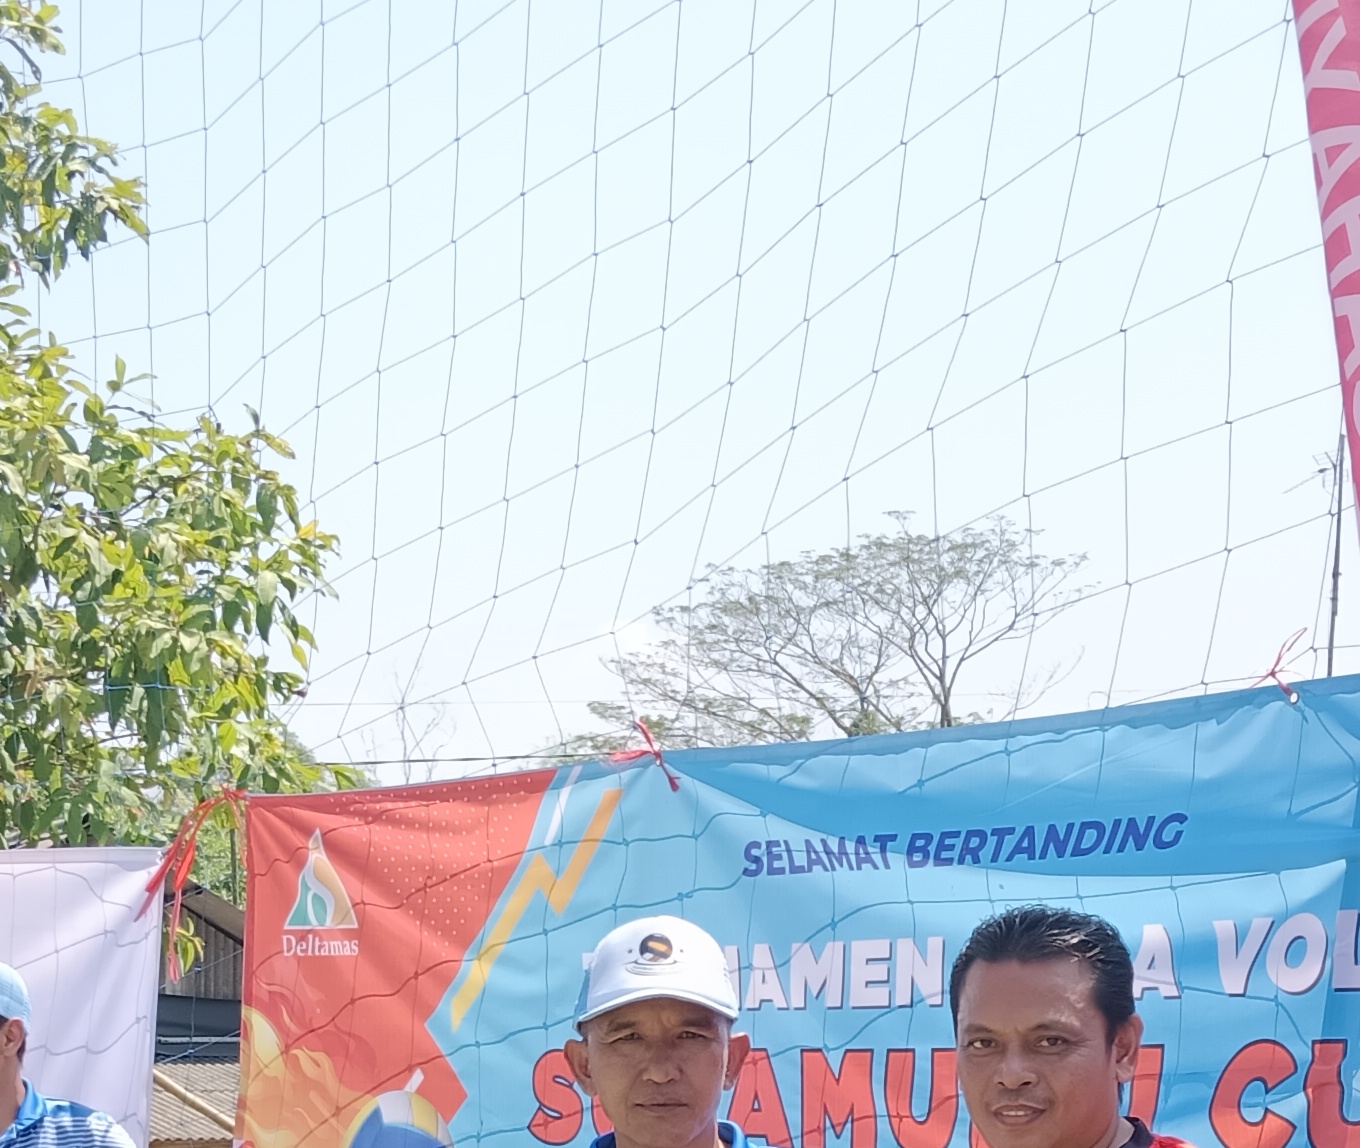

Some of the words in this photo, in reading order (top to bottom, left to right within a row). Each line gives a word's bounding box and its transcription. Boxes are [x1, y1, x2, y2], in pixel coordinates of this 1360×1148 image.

[742, 833, 899, 878] SELAMAT
[905, 812, 1189, 868] BERTANDING
[282, 934, 360, 957] Deltamas
